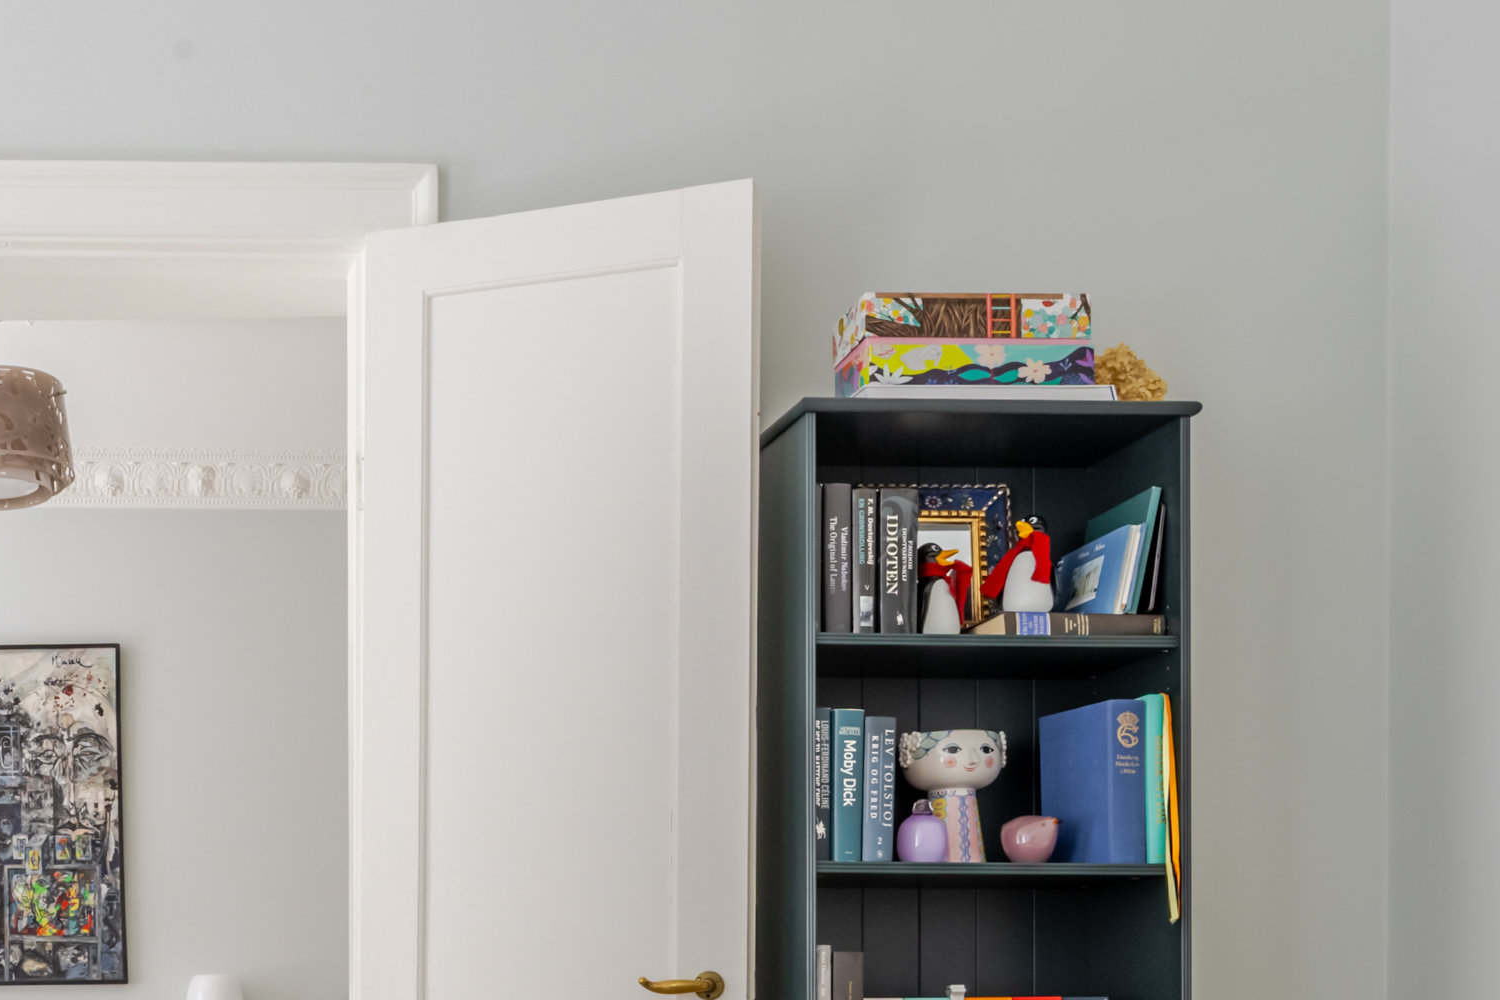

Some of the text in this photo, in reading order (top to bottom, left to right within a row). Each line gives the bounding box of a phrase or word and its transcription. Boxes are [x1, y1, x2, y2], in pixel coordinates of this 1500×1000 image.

[830, 516, 838, 531] The
[867, 506, 874, 517] M.
[828, 531, 838, 563] Original
[830, 563, 838, 573] of
[841, 526, 849, 592] Vladimir Nabokov
[866, 517, 874, 565] Dostojevskij
[886, 514, 899, 595] IDIOTEN
[820, 720, 830, 809] LOUIS-FERDINAND CÉLINE
[840, 740, 857, 807] Moby Dick
[870, 735, 879, 819] KRIG OG FRED
[882, 729, 895, 828] LEV TOLSTOJ
[876, 837, 883, 845] 2
